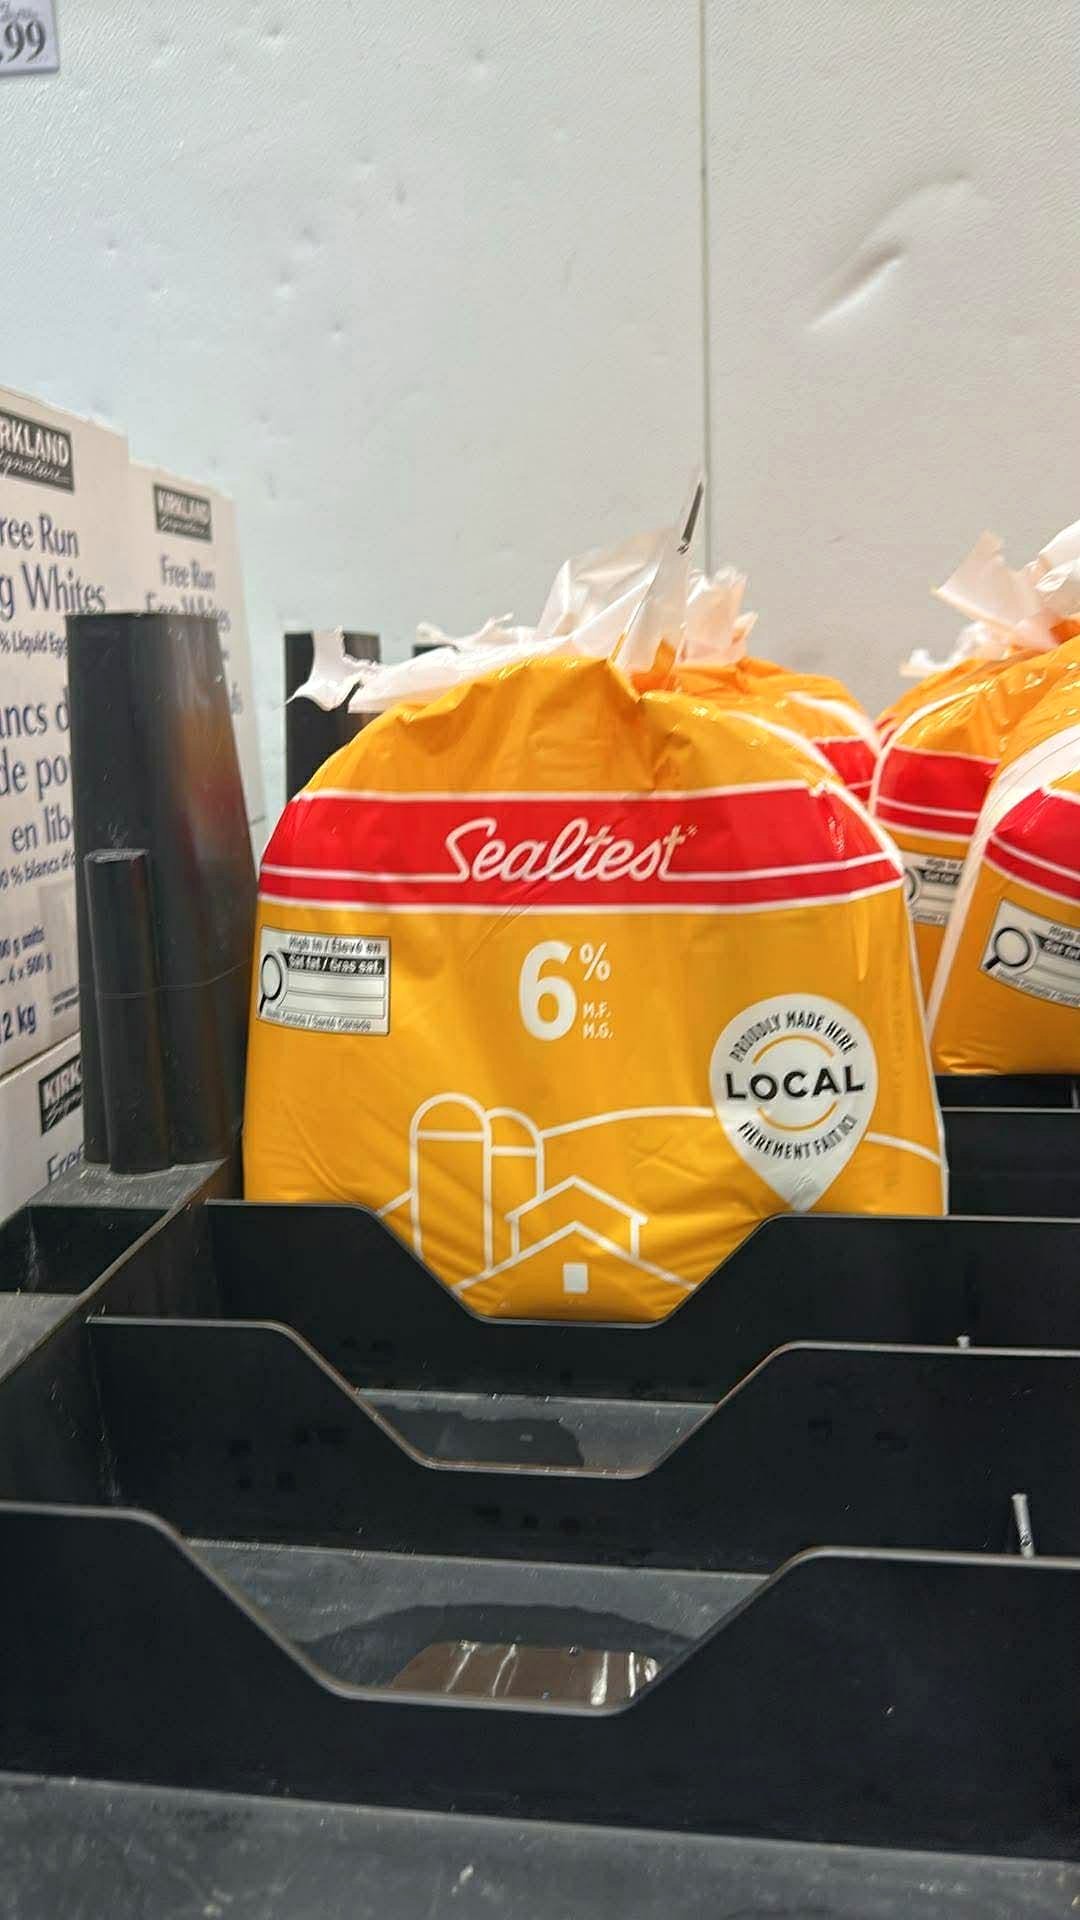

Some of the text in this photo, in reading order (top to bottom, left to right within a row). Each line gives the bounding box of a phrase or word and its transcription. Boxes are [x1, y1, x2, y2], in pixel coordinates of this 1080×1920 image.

[39, 513, 79, 558] Run
[21, 561, 106, 613] Whites
[12, 822, 38, 853] en
[445, 817, 687, 882] Sealtest
[17, 1004, 37, 1034] kg
[729, 1010, 858, 1063] PROUDLY MADE HERE
[725, 1065, 865, 1101] LOCAL
